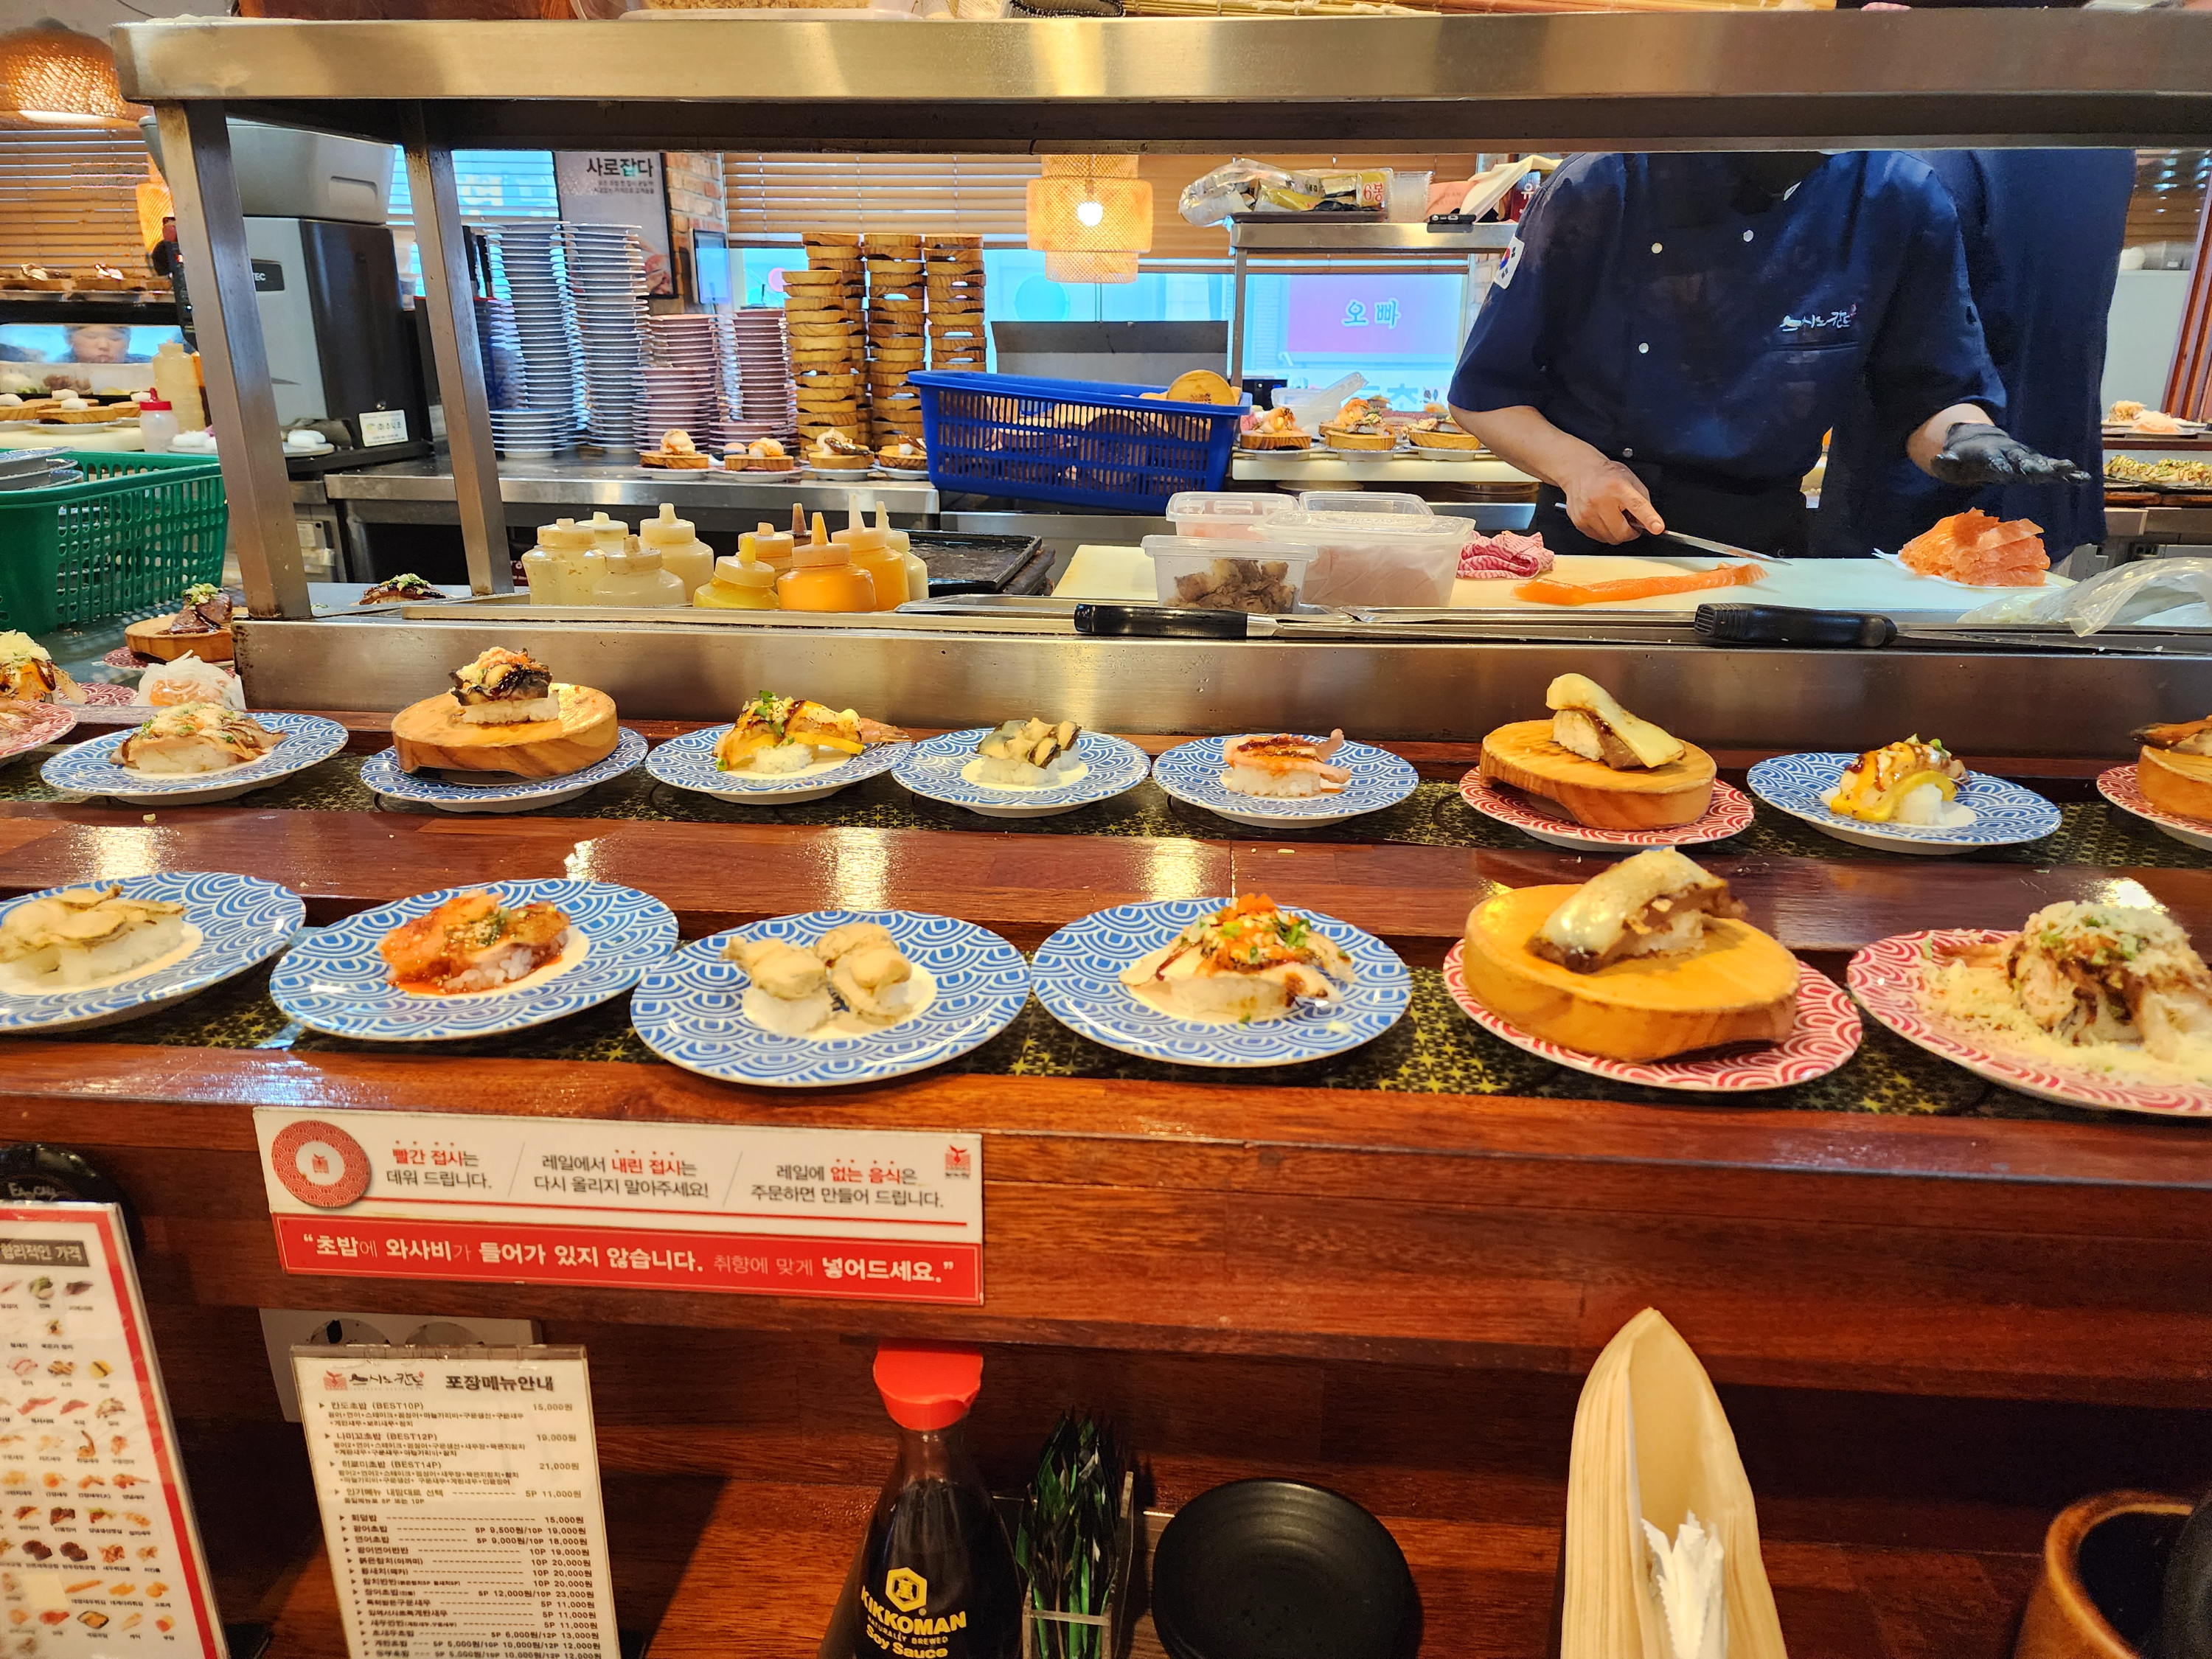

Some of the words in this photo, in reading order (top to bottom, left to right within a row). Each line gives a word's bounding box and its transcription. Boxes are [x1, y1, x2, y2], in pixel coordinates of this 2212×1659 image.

[586, 157, 653, 178] 사로잡다
[1363, 183, 1383, 202] 6봉
[392, 1148, 425, 1165] 빨간
[431, 1150, 480, 1167] 접시는
[542, 1155, 606, 1173] 레일에서
[612, 1157, 644, 1175] 내린
[649, 1159, 698, 1178] 접시는
[386, 1169, 419, 1186] 데워
[423, 1171, 493, 1190] 드립니다.
[776, 1164, 825, 1181] 레일에
[830, 1166, 863, 1183] 없는
[868, 1166, 918, 1186] 음식은
[534, 1175, 566, 1192] 다시
[571, 1177, 619, 1194] 올리지
[625, 1179, 709, 1199] 말아주세요!
[751, 1184, 815, 1203] 주문하면
[821, 1186, 869, 1205] 만들어
[874, 1190, 945, 1208] 드립니다.
[55, 1245, 83, 1263] 가격
[386, 1238, 471, 1262] 와사비가
[479, 1242, 546, 1265] 들어가
[554, 1243, 600, 1267] 있지
[607, 1247, 703, 1273] 않습니다.
[713, 1255, 769, 1275] 취향에
[776, 1256, 814, 1277] 맞게
[445, 1374, 554, 1392] 포장메뉴안내
[331, 1402, 366, 1410] 칸도초밥
[372, 1402, 424, 1410] (BEST10P)
[533, 1403, 573, 1411] 15,000원
[386, 1433, 438, 1441] (BEST12P)
[536, 1434, 577, 1442] 19,000원
[391, 1461, 442, 1470] (BEST14P)
[539, 1462, 580, 1471] 21,000원
[347, 1488, 382, 1496] 인기메뉴
[386, 1489, 421, 1497] 내맘대로
[426, 1489, 443, 1498] 선택
[542, 1490, 582, 1498] 11,000원
[545, 1516, 584, 1524] 15,000원
[353, 1525, 388, 1533] 광어초밥
[547, 1527, 586, 1535] 19,000원
[549, 1537, 588, 1545] 18,000원
[551, 1548, 590, 1557] 19,000원
[554, 1570, 593, 1578] 20,000원
[554, 1580, 593, 1588] 20,000원
[555, 1590, 594, 1599] 23,000원
[557, 1601, 595, 1609] 11,000원
[860, 1585, 967, 1636] KIKKOMAN
[560, 1621, 598, 1630] 11,000원
[867, 1614, 907, 1643] NATURALLY
[911, 1635, 949, 1646] BREWED
[561, 1632, 599, 1640] 13,000원
[563, 1642, 601, 1650] 12,000원
[866, 1624, 889, 1650] Soy
[892, 1641, 948, 1659] Sauce
